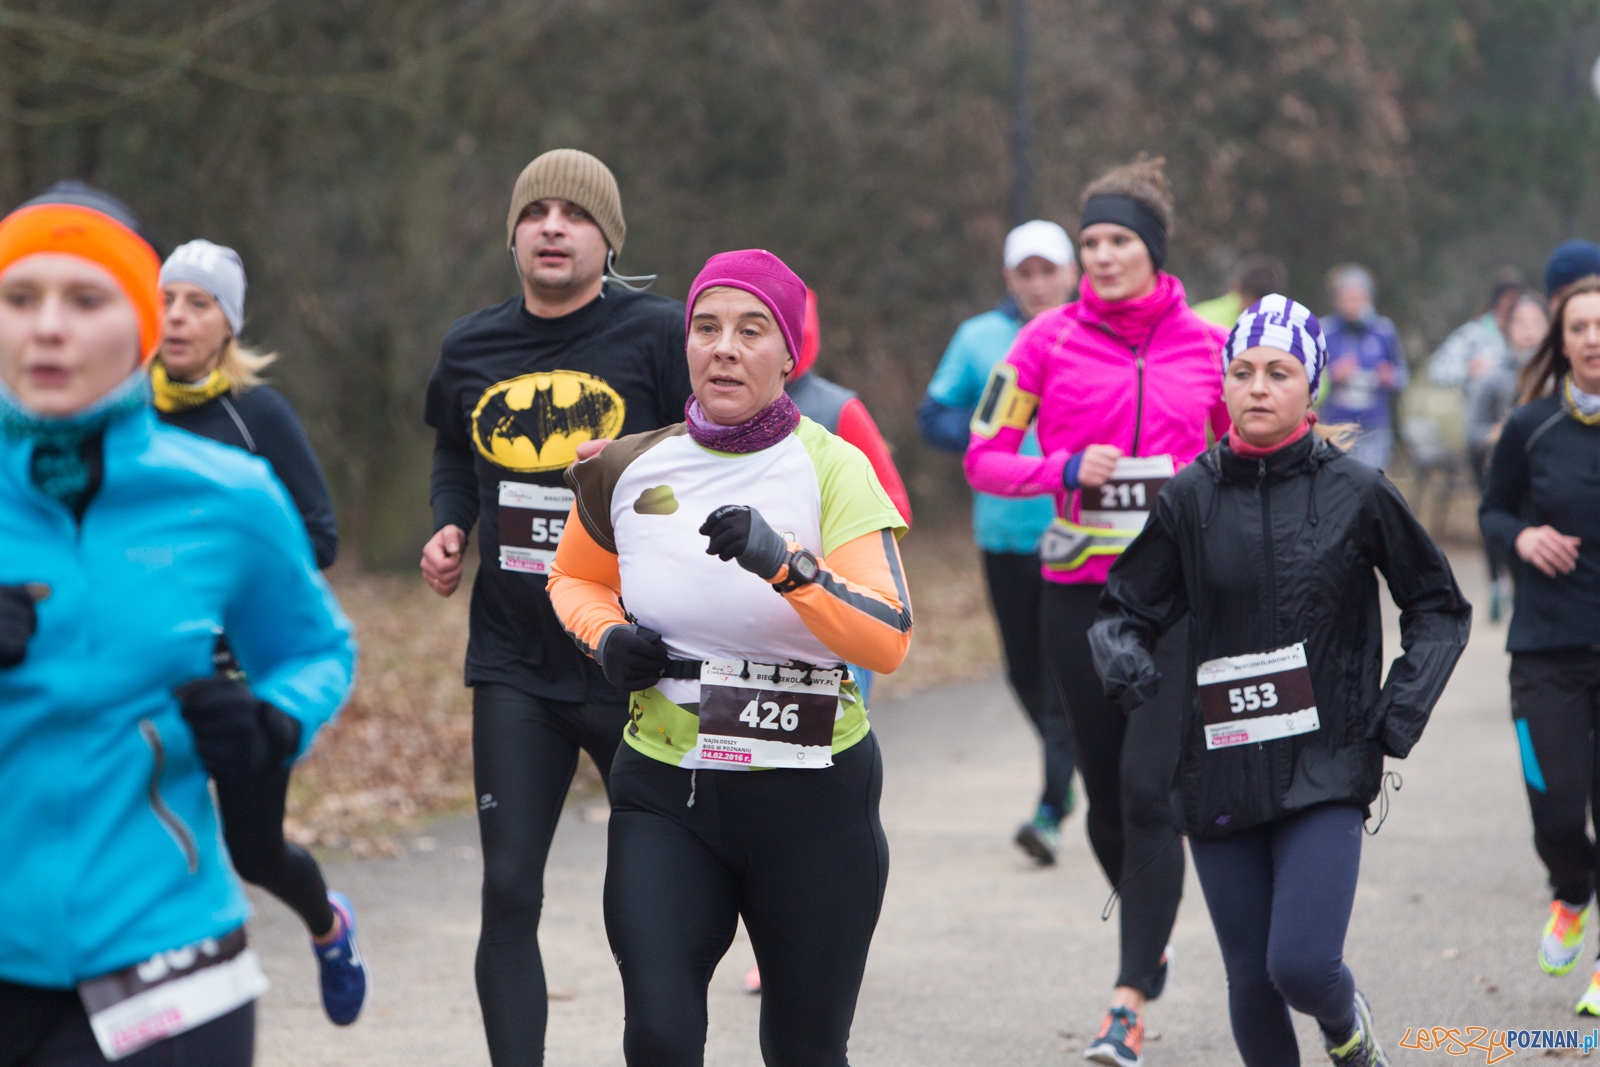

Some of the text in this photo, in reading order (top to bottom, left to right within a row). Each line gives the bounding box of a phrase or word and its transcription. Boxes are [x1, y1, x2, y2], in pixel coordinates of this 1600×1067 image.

[1100, 482, 1147, 508] 211
[1228, 682, 1279, 714] 553
[739, 700, 799, 731] 426
[703, 738, 737, 746] NAJSŁODSZY
[723, 746, 752, 754] POZNANIU
[702, 751, 743, 762] 14.02.2016
